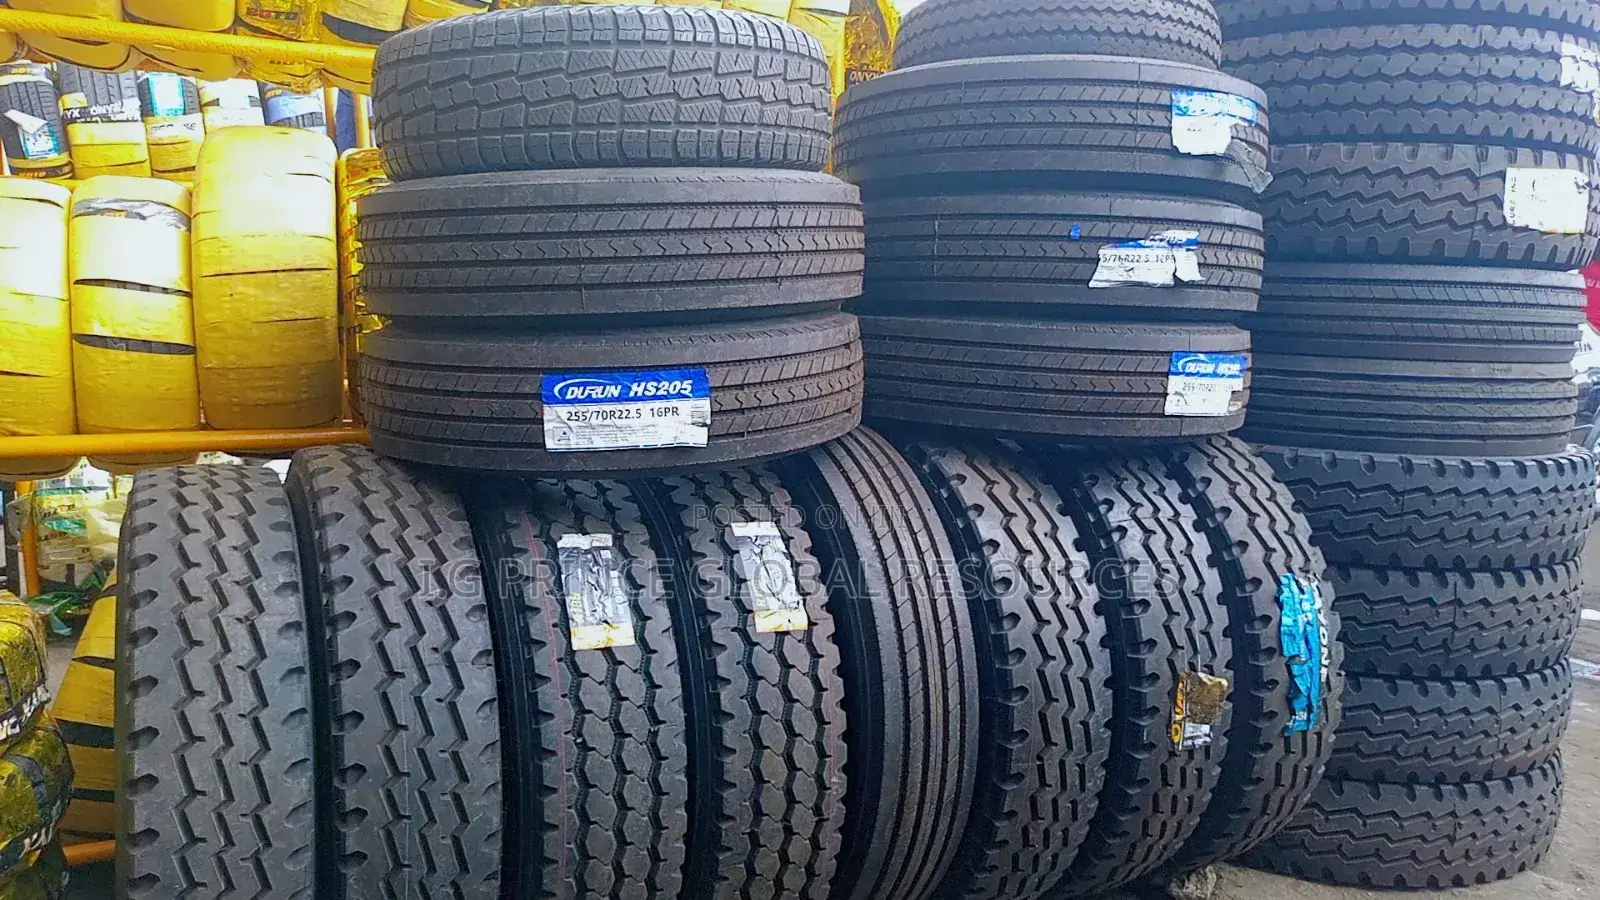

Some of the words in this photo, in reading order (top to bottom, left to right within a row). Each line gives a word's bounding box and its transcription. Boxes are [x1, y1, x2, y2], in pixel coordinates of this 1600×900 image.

[565, 385, 622, 400] DURUN
[629, 380, 693, 398] HS205
[566, 408, 642, 422] 255/70R22.5
[650, 406, 680, 418] 16PR
